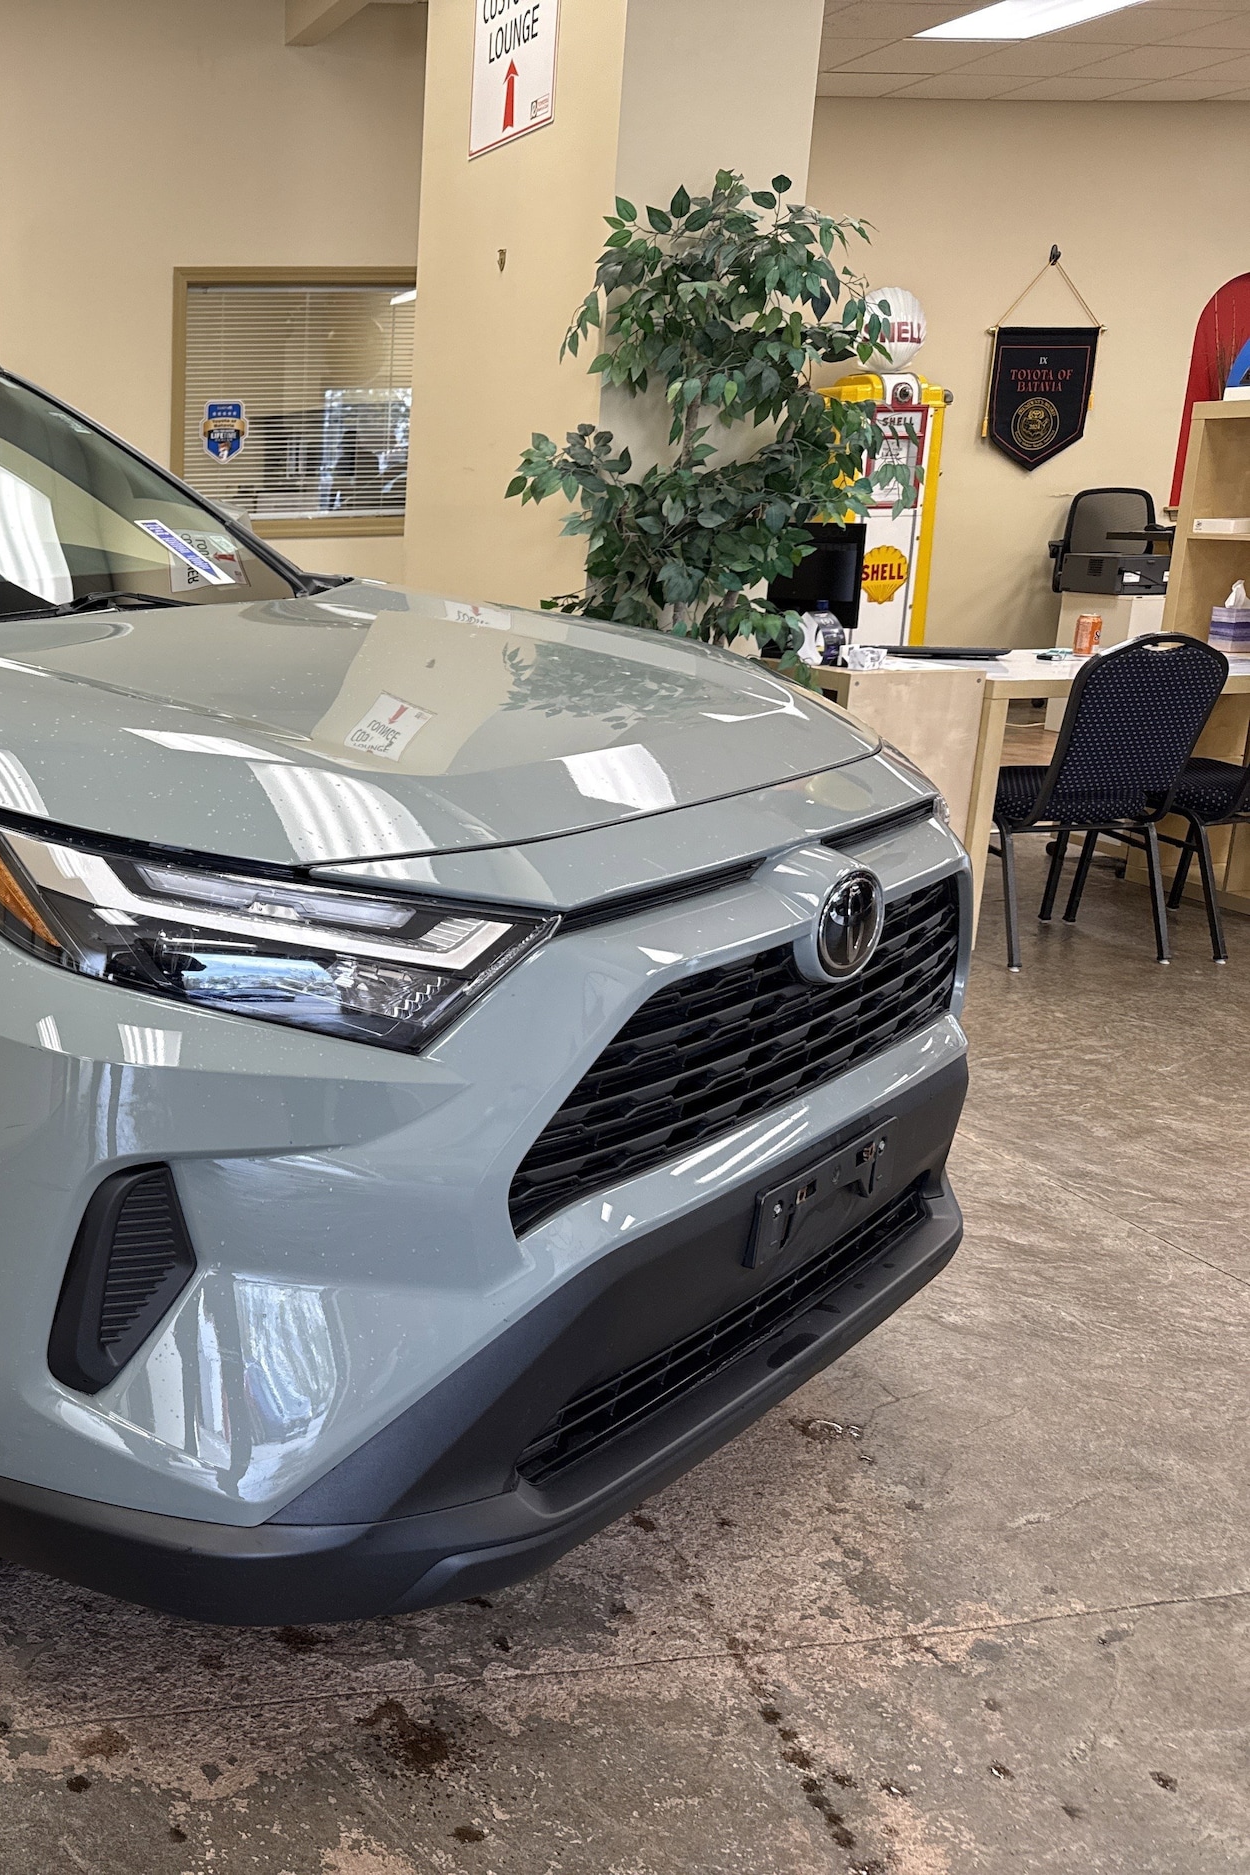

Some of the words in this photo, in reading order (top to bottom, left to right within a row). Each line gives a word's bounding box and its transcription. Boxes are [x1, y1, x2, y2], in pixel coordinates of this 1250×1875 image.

[488, 3, 540, 65] LOUNGE
[1038, 356, 1049, 365] IX
[1010, 369, 1054, 381] TOYOTA
[1057, 369, 1074, 381] OF
[1016, 381, 1063, 392] BATAVIA
[882, 416, 914, 427] SHELL
[861, 563, 904, 581] SHELL
